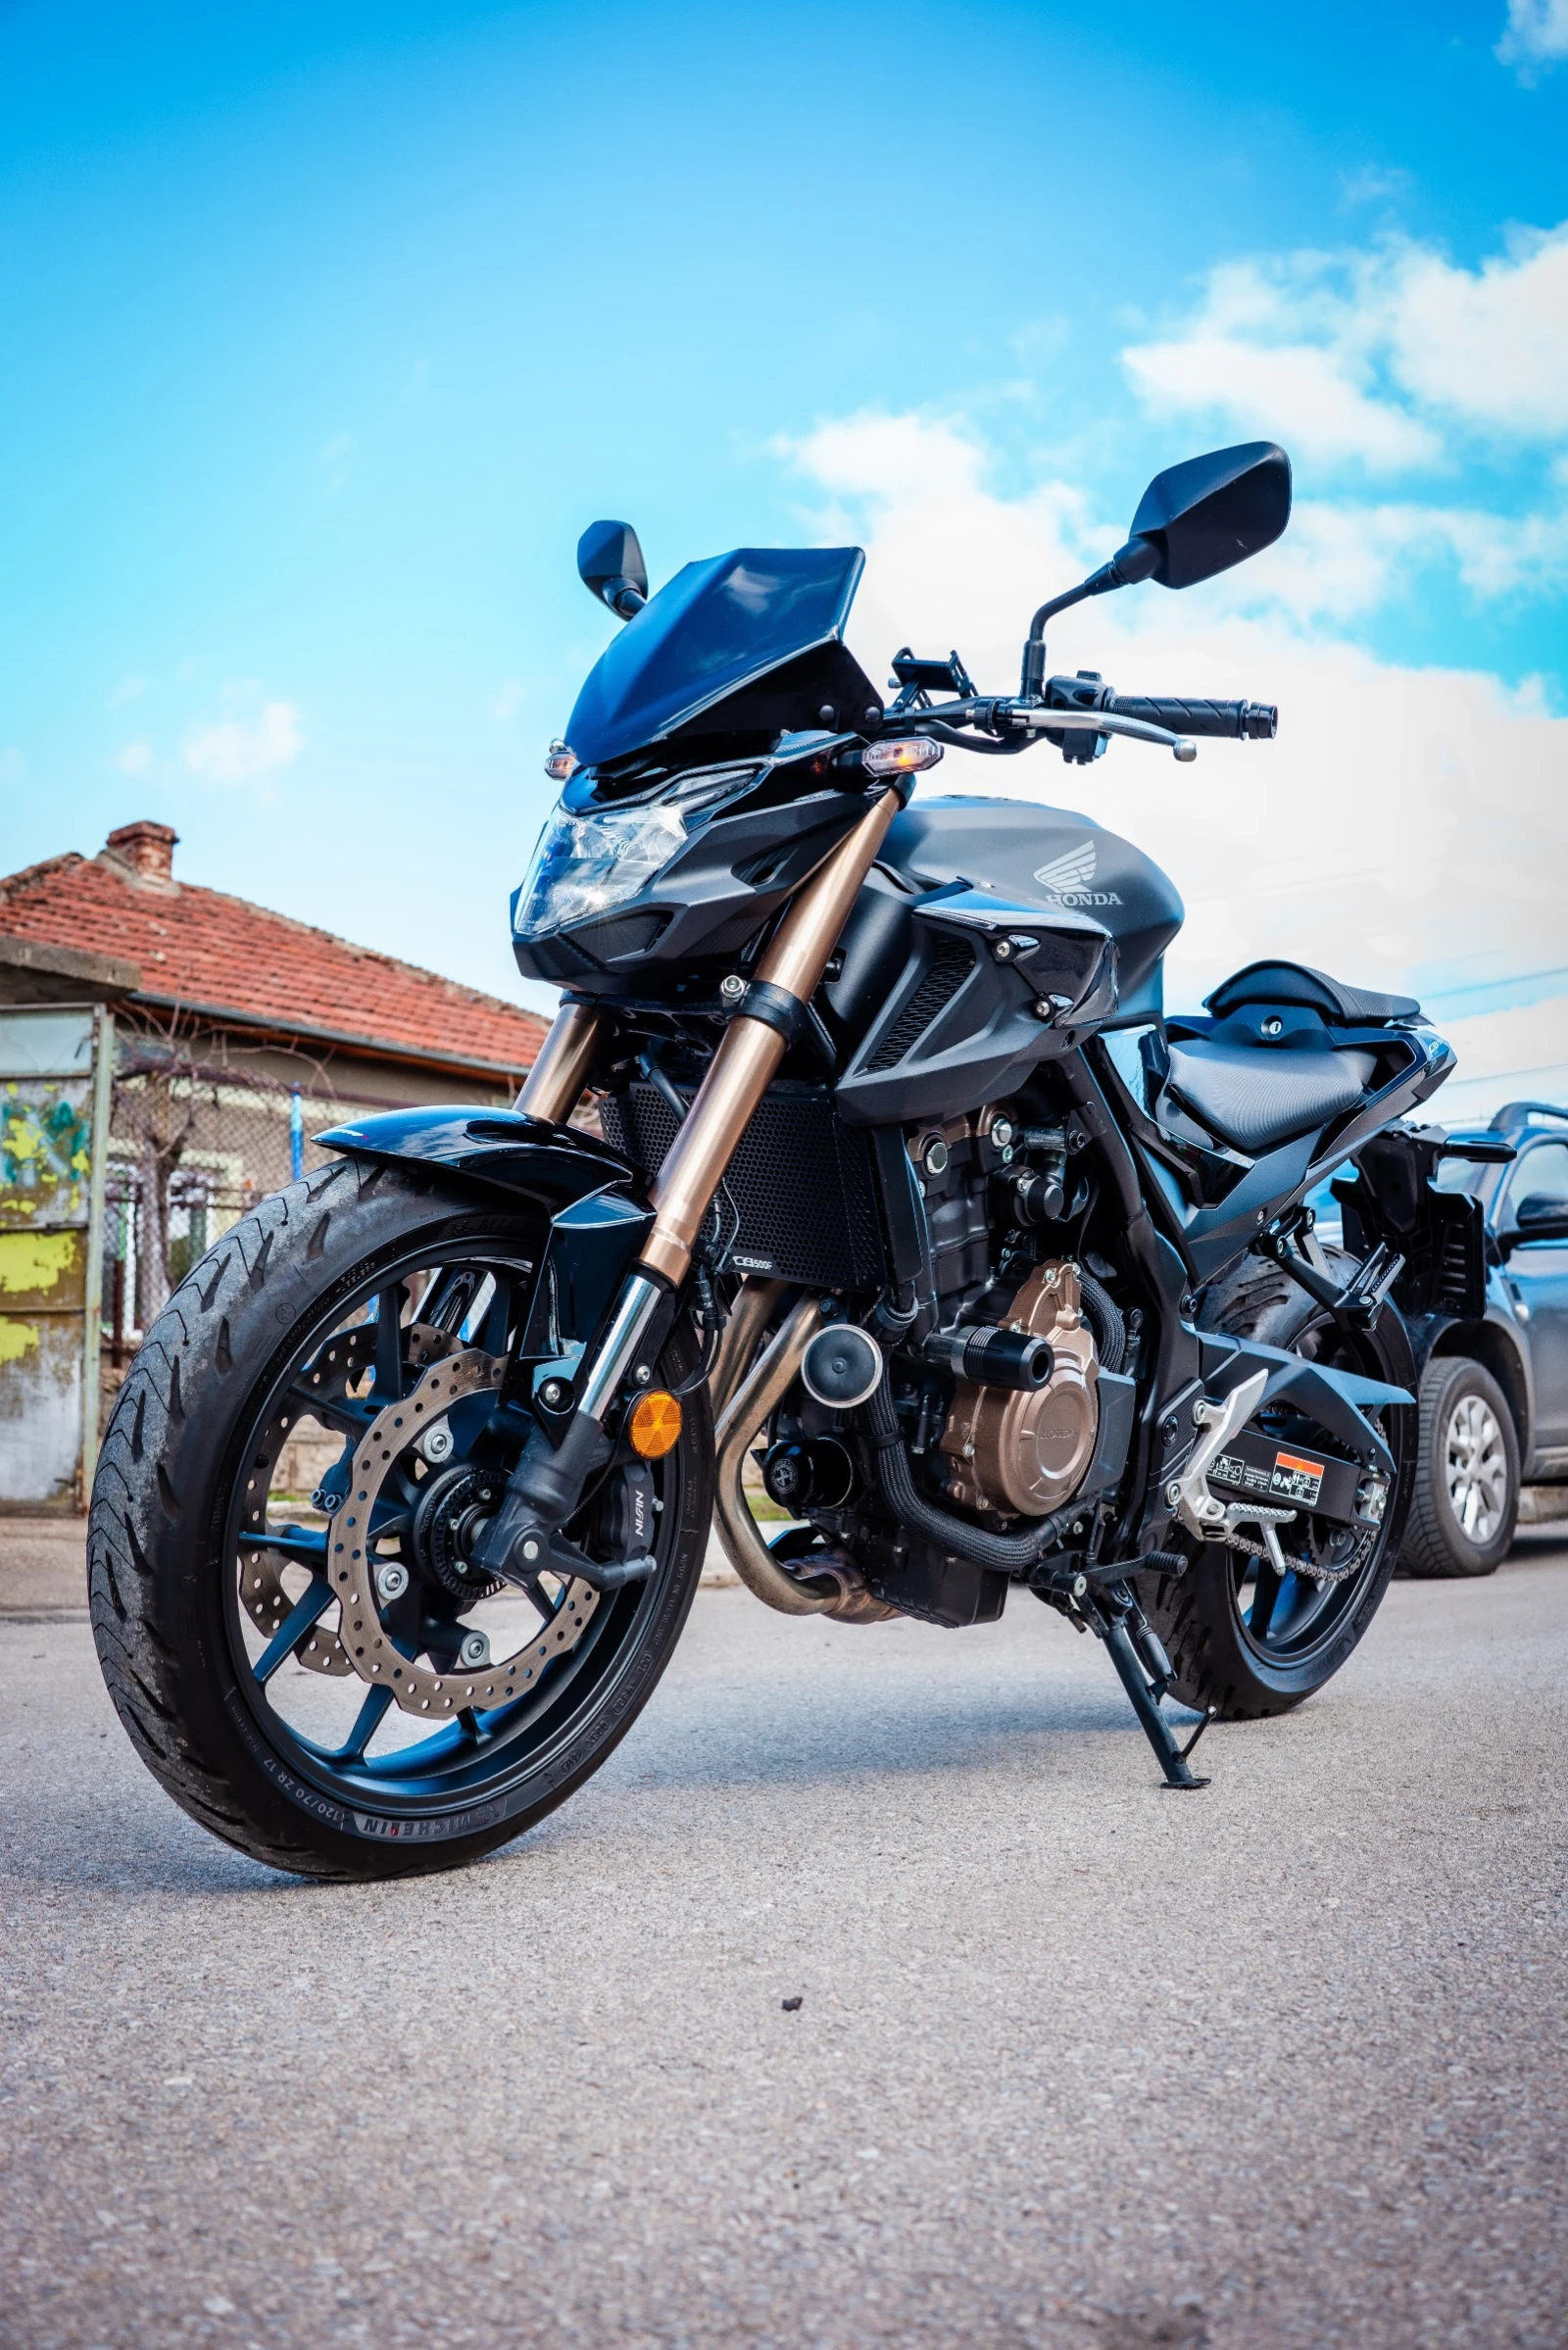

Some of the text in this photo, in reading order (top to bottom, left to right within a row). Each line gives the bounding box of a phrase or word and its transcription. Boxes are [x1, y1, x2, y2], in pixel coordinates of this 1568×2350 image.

[1045, 893, 1124, 906] HONDA
[635, 1490, 645, 1538] NISSIN
[263, 1758, 339, 1822] 120/70 ZR 17
[363, 1813, 471, 1836] MICHELIN
